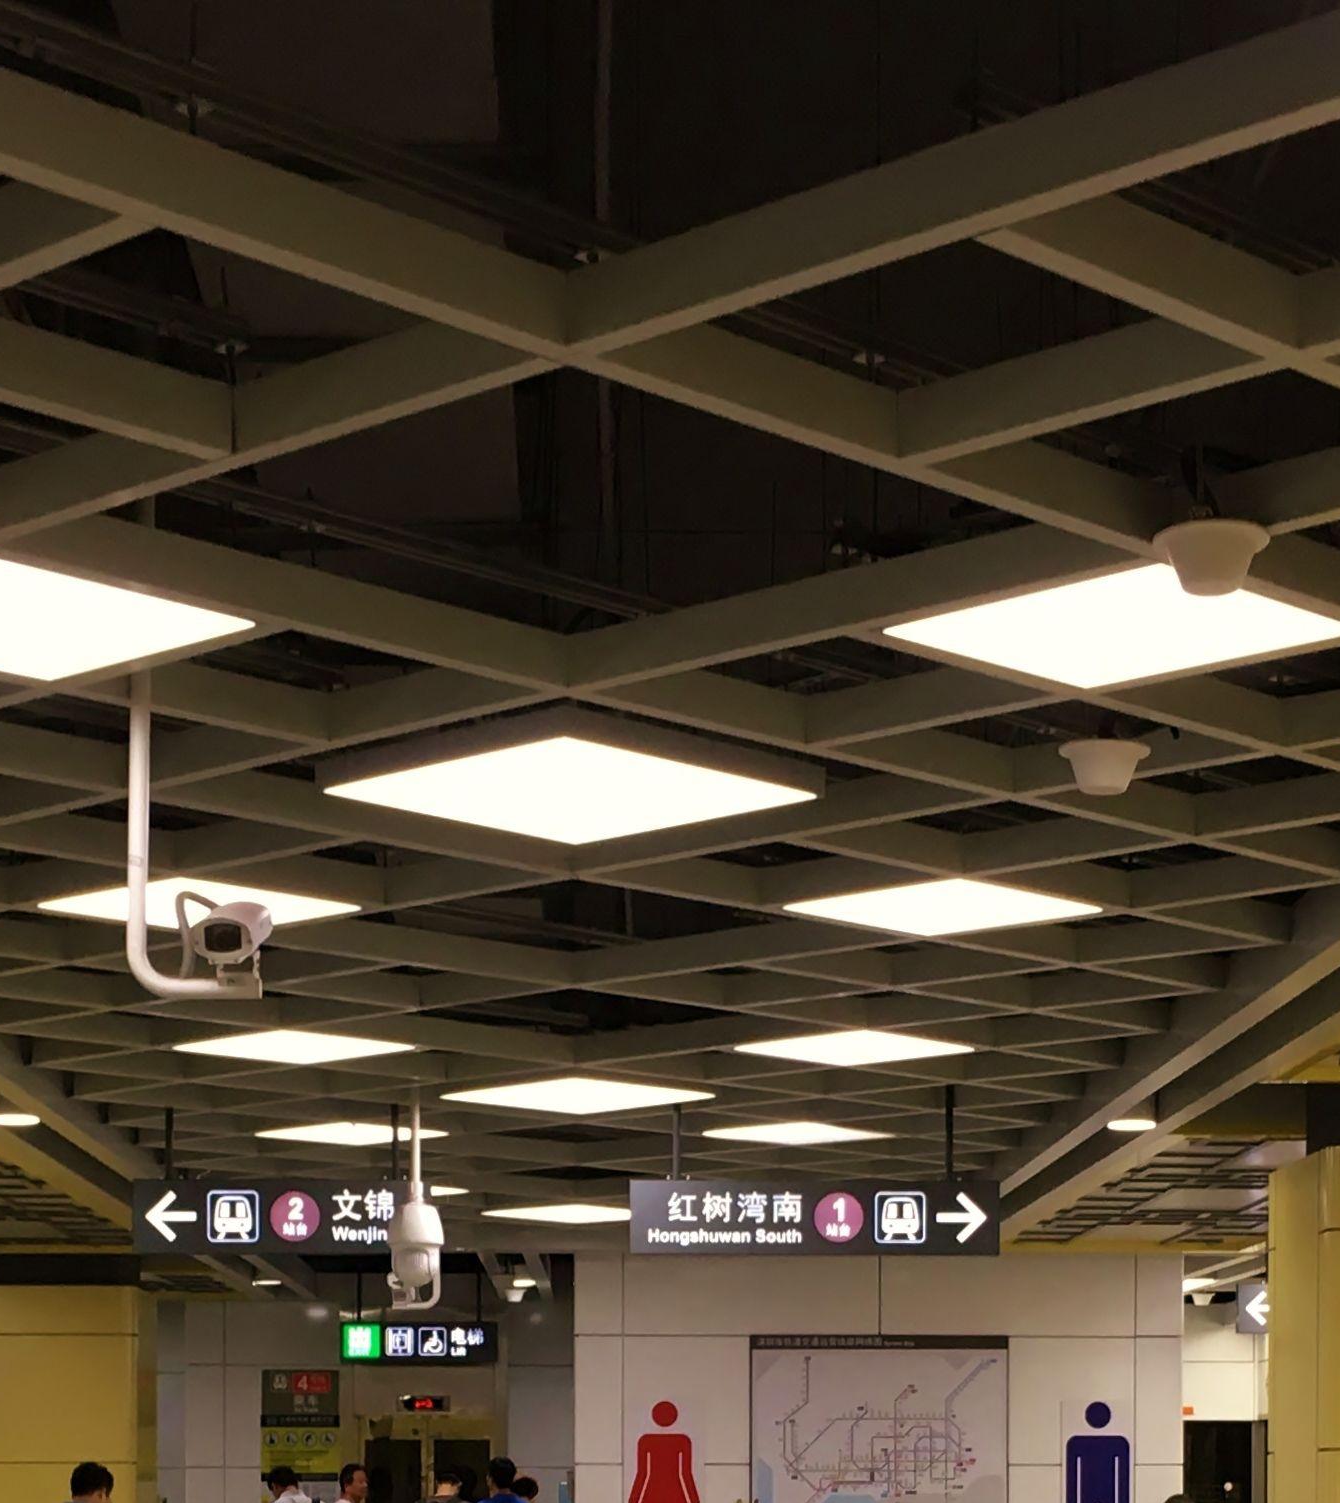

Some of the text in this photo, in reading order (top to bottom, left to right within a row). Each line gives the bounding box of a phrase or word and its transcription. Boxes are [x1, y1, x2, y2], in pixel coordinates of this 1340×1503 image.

[287, 1197, 304, 1221] 2
[331, 1188, 395, 1222] 文锦
[667, 1191, 803, 1224] 红树湾南
[832, 1197, 846, 1223] 1
[331, 1226, 388, 1245] Wenjin
[648, 1228, 803, 1246] Hongshuwan South
